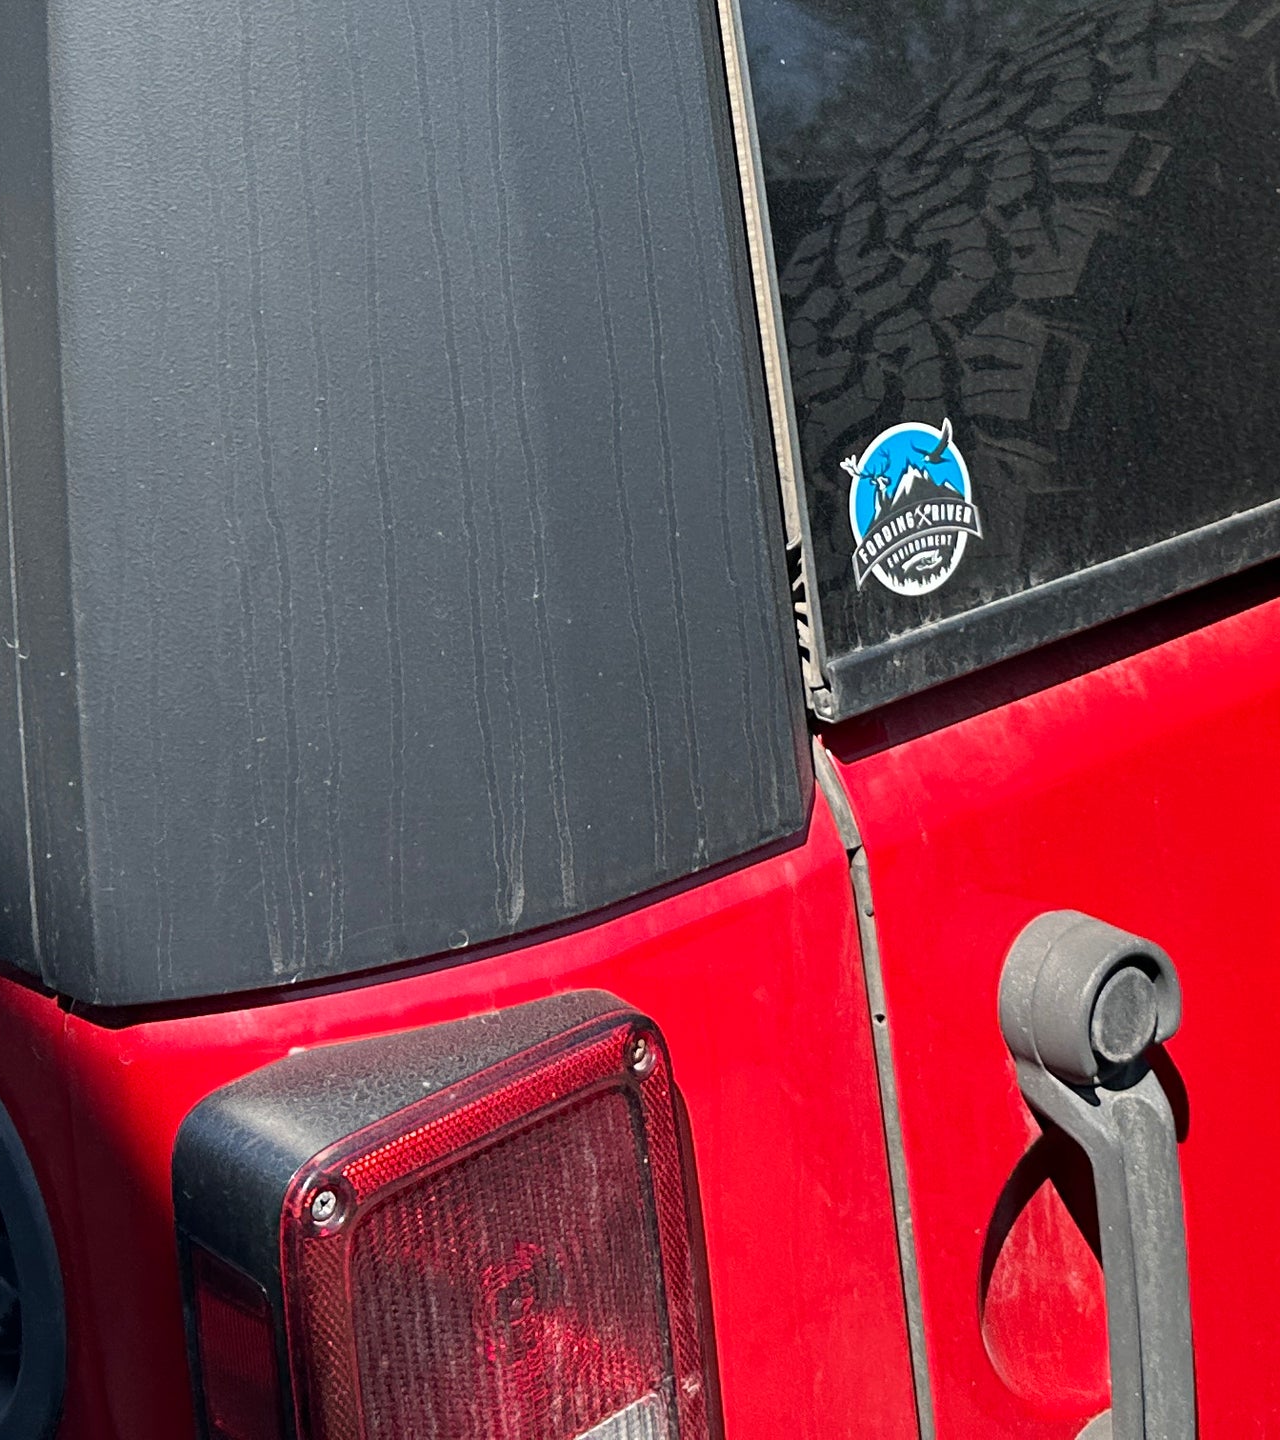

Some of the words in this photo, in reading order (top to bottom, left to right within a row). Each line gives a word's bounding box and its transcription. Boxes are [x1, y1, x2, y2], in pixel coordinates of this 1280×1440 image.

[858, 511, 915, 564] FORDING
[931, 503, 972, 524] RIVER
[886, 534, 952, 569] ENVIRONMENT
